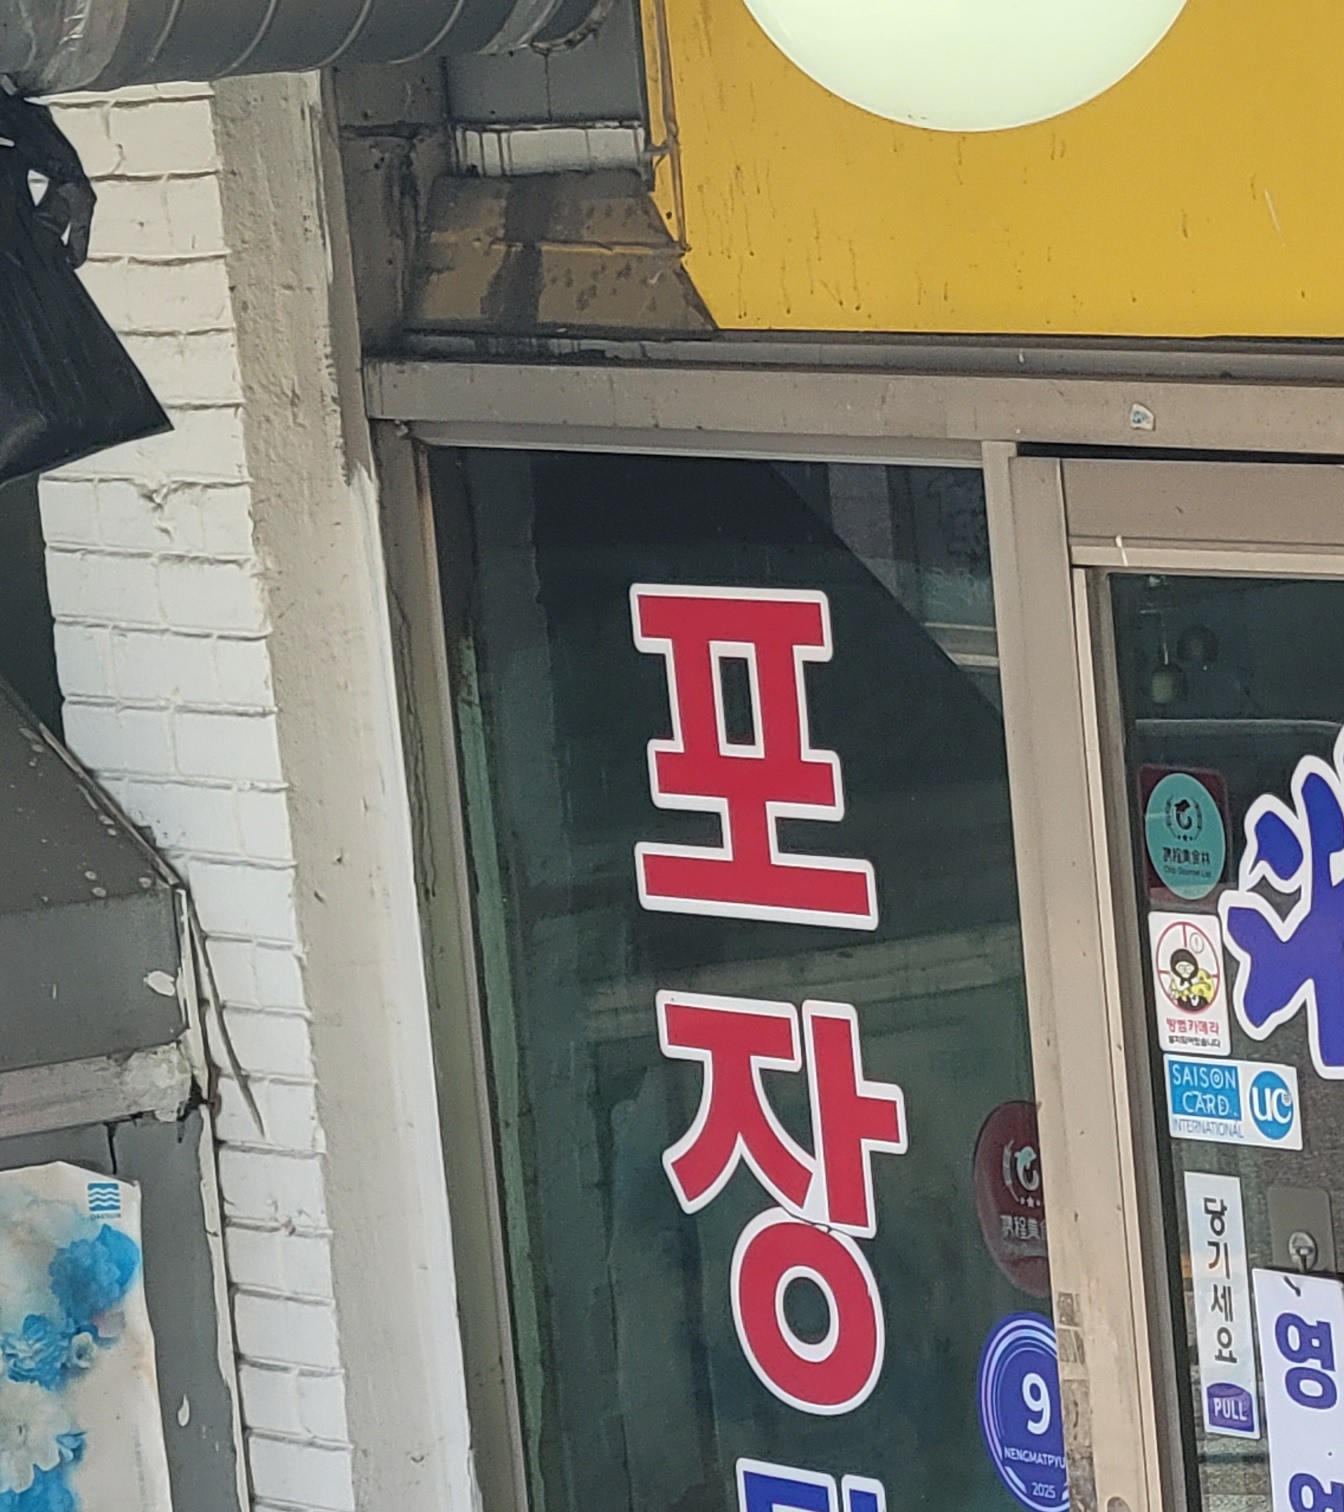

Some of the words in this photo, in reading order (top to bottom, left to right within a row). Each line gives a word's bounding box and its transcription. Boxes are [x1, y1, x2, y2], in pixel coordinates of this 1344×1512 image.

[1172, 1064, 1236, 1089] SAISON
[1182, 1091, 1230, 1116] CARD
[1172, 1119, 1244, 1139] INTERNATIONAL
[1203, 1197, 1237, 1364] 당기세요
[1022, 1372, 1051, 1435] 9
[1213, 1397, 1248, 1422] PULL
[1032, 1482, 1056, 1498] 2025
